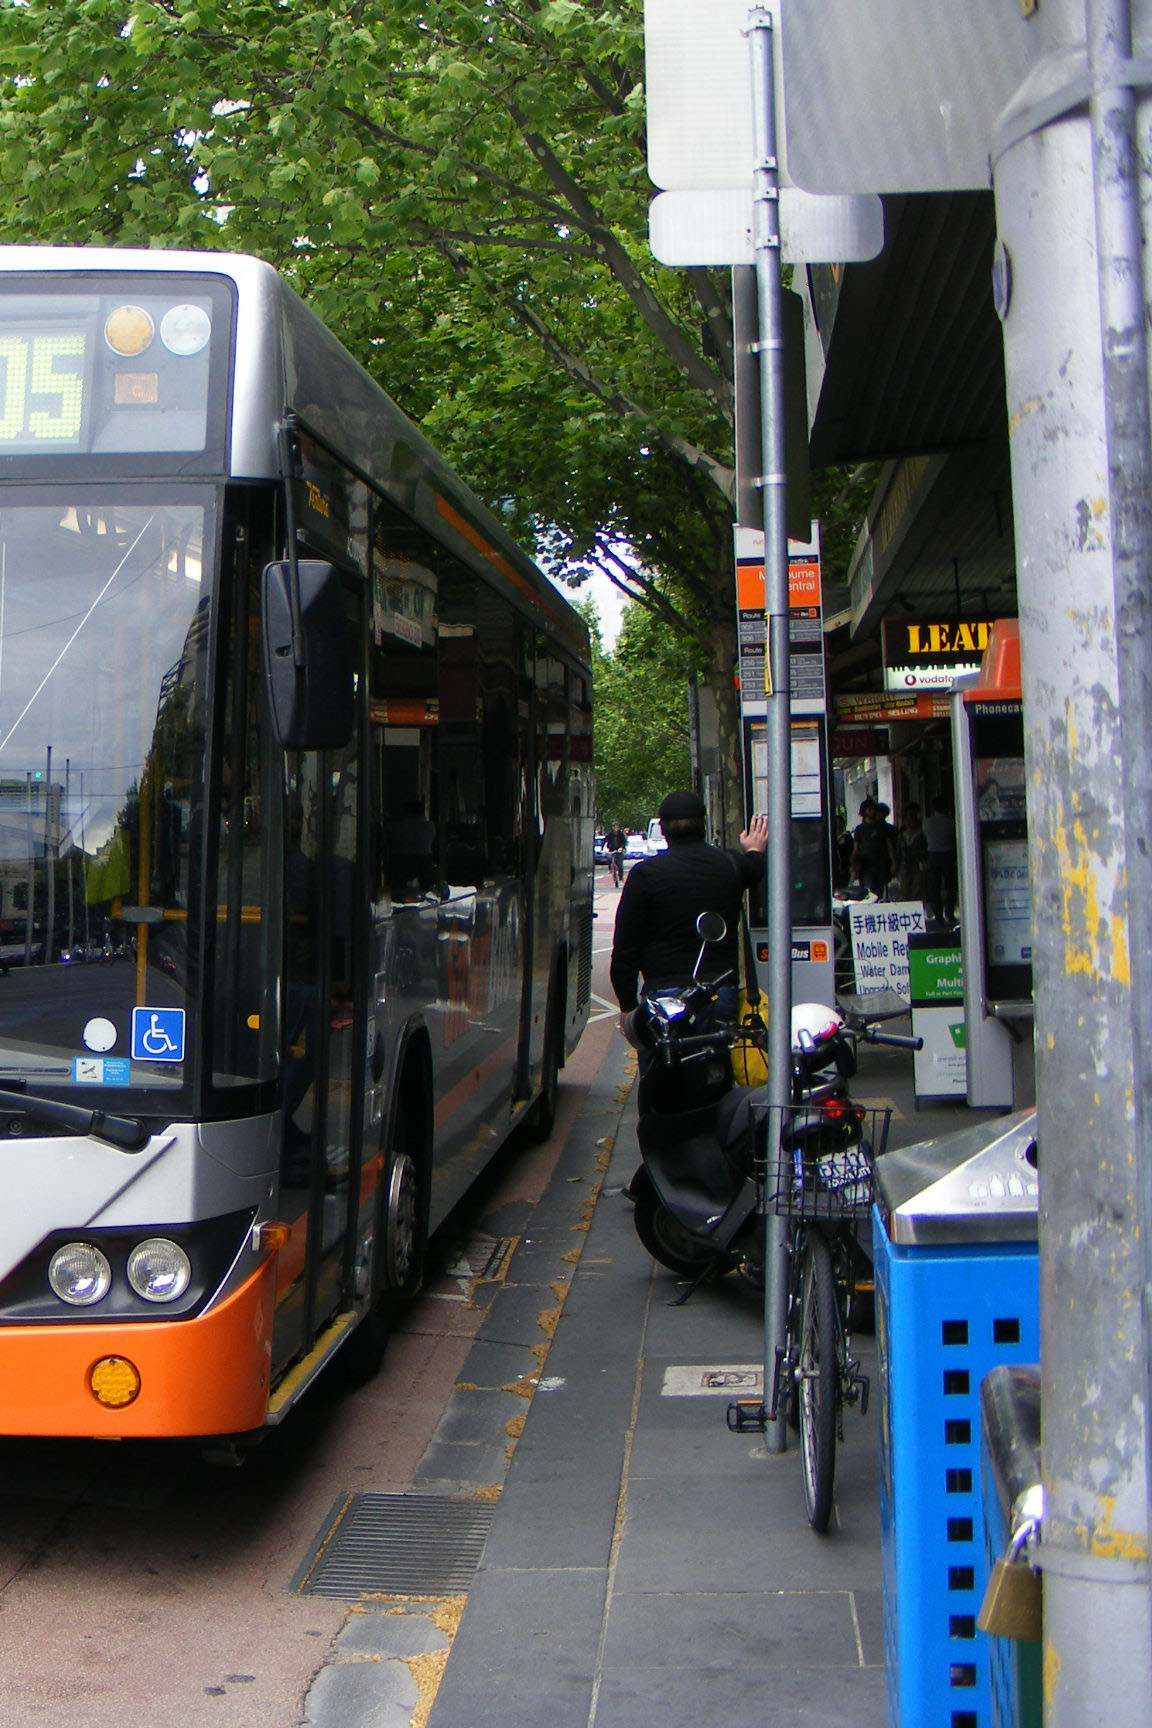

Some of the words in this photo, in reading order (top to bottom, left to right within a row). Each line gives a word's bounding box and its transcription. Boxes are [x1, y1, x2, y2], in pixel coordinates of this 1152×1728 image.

[788, 580, 816, 592] entral
[856, 941, 888, 959] Mobile
[860, 964, 886, 977] Water
